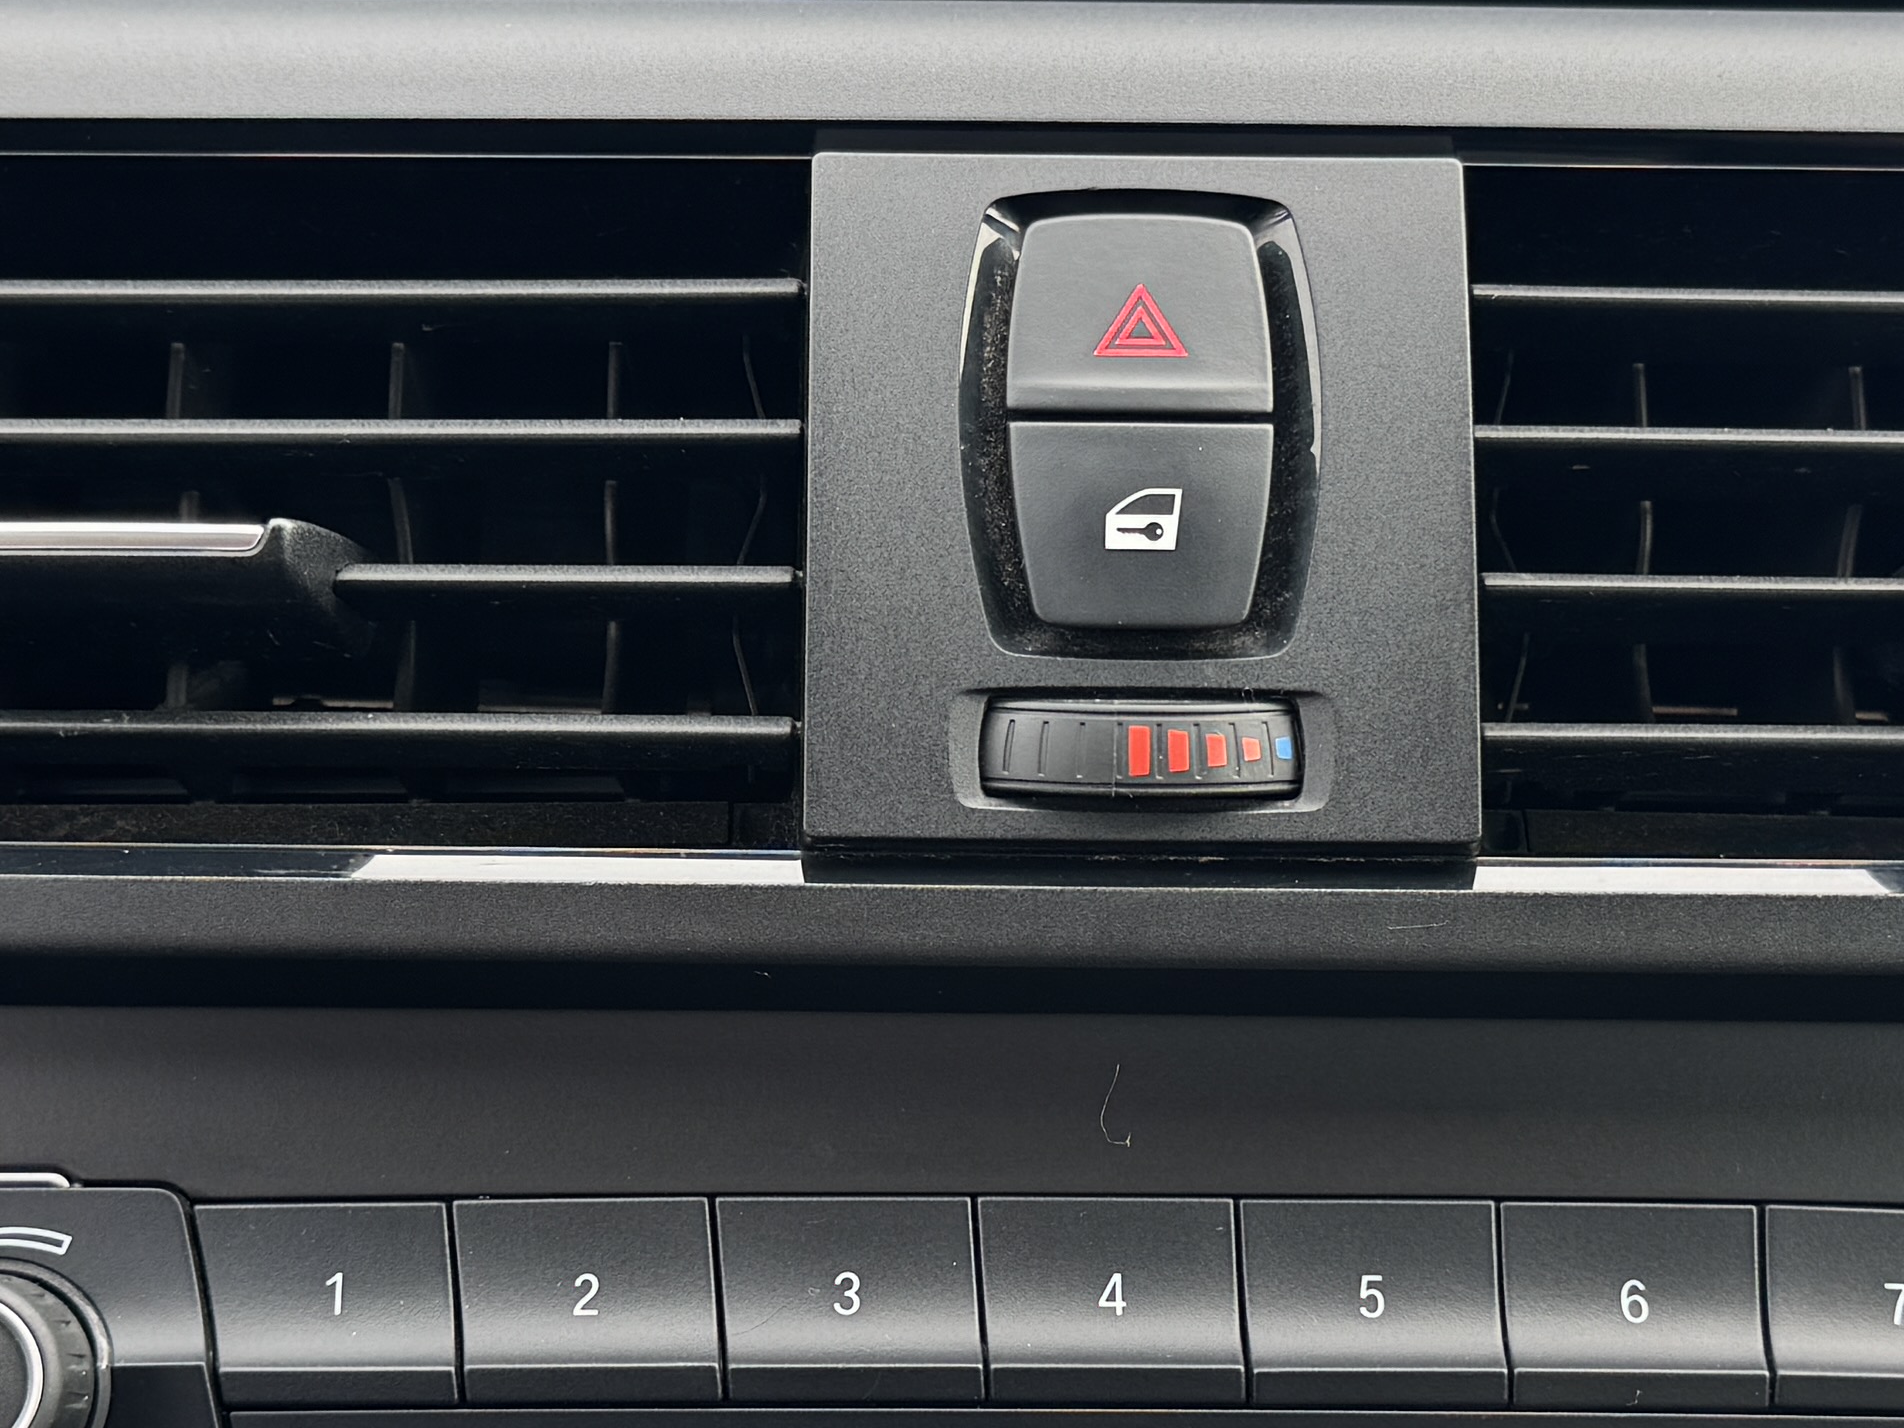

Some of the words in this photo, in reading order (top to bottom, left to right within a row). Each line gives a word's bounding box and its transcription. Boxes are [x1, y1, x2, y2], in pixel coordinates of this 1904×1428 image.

[324, 1270, 346, 1317] 1
[571, 1272, 600, 1318] 2
[832, 1271, 862, 1318] 3
[1097, 1271, 1127, 1318] 4
[1358, 1274, 1386, 1320] 5
[1619, 1278, 1650, 1324] 6
